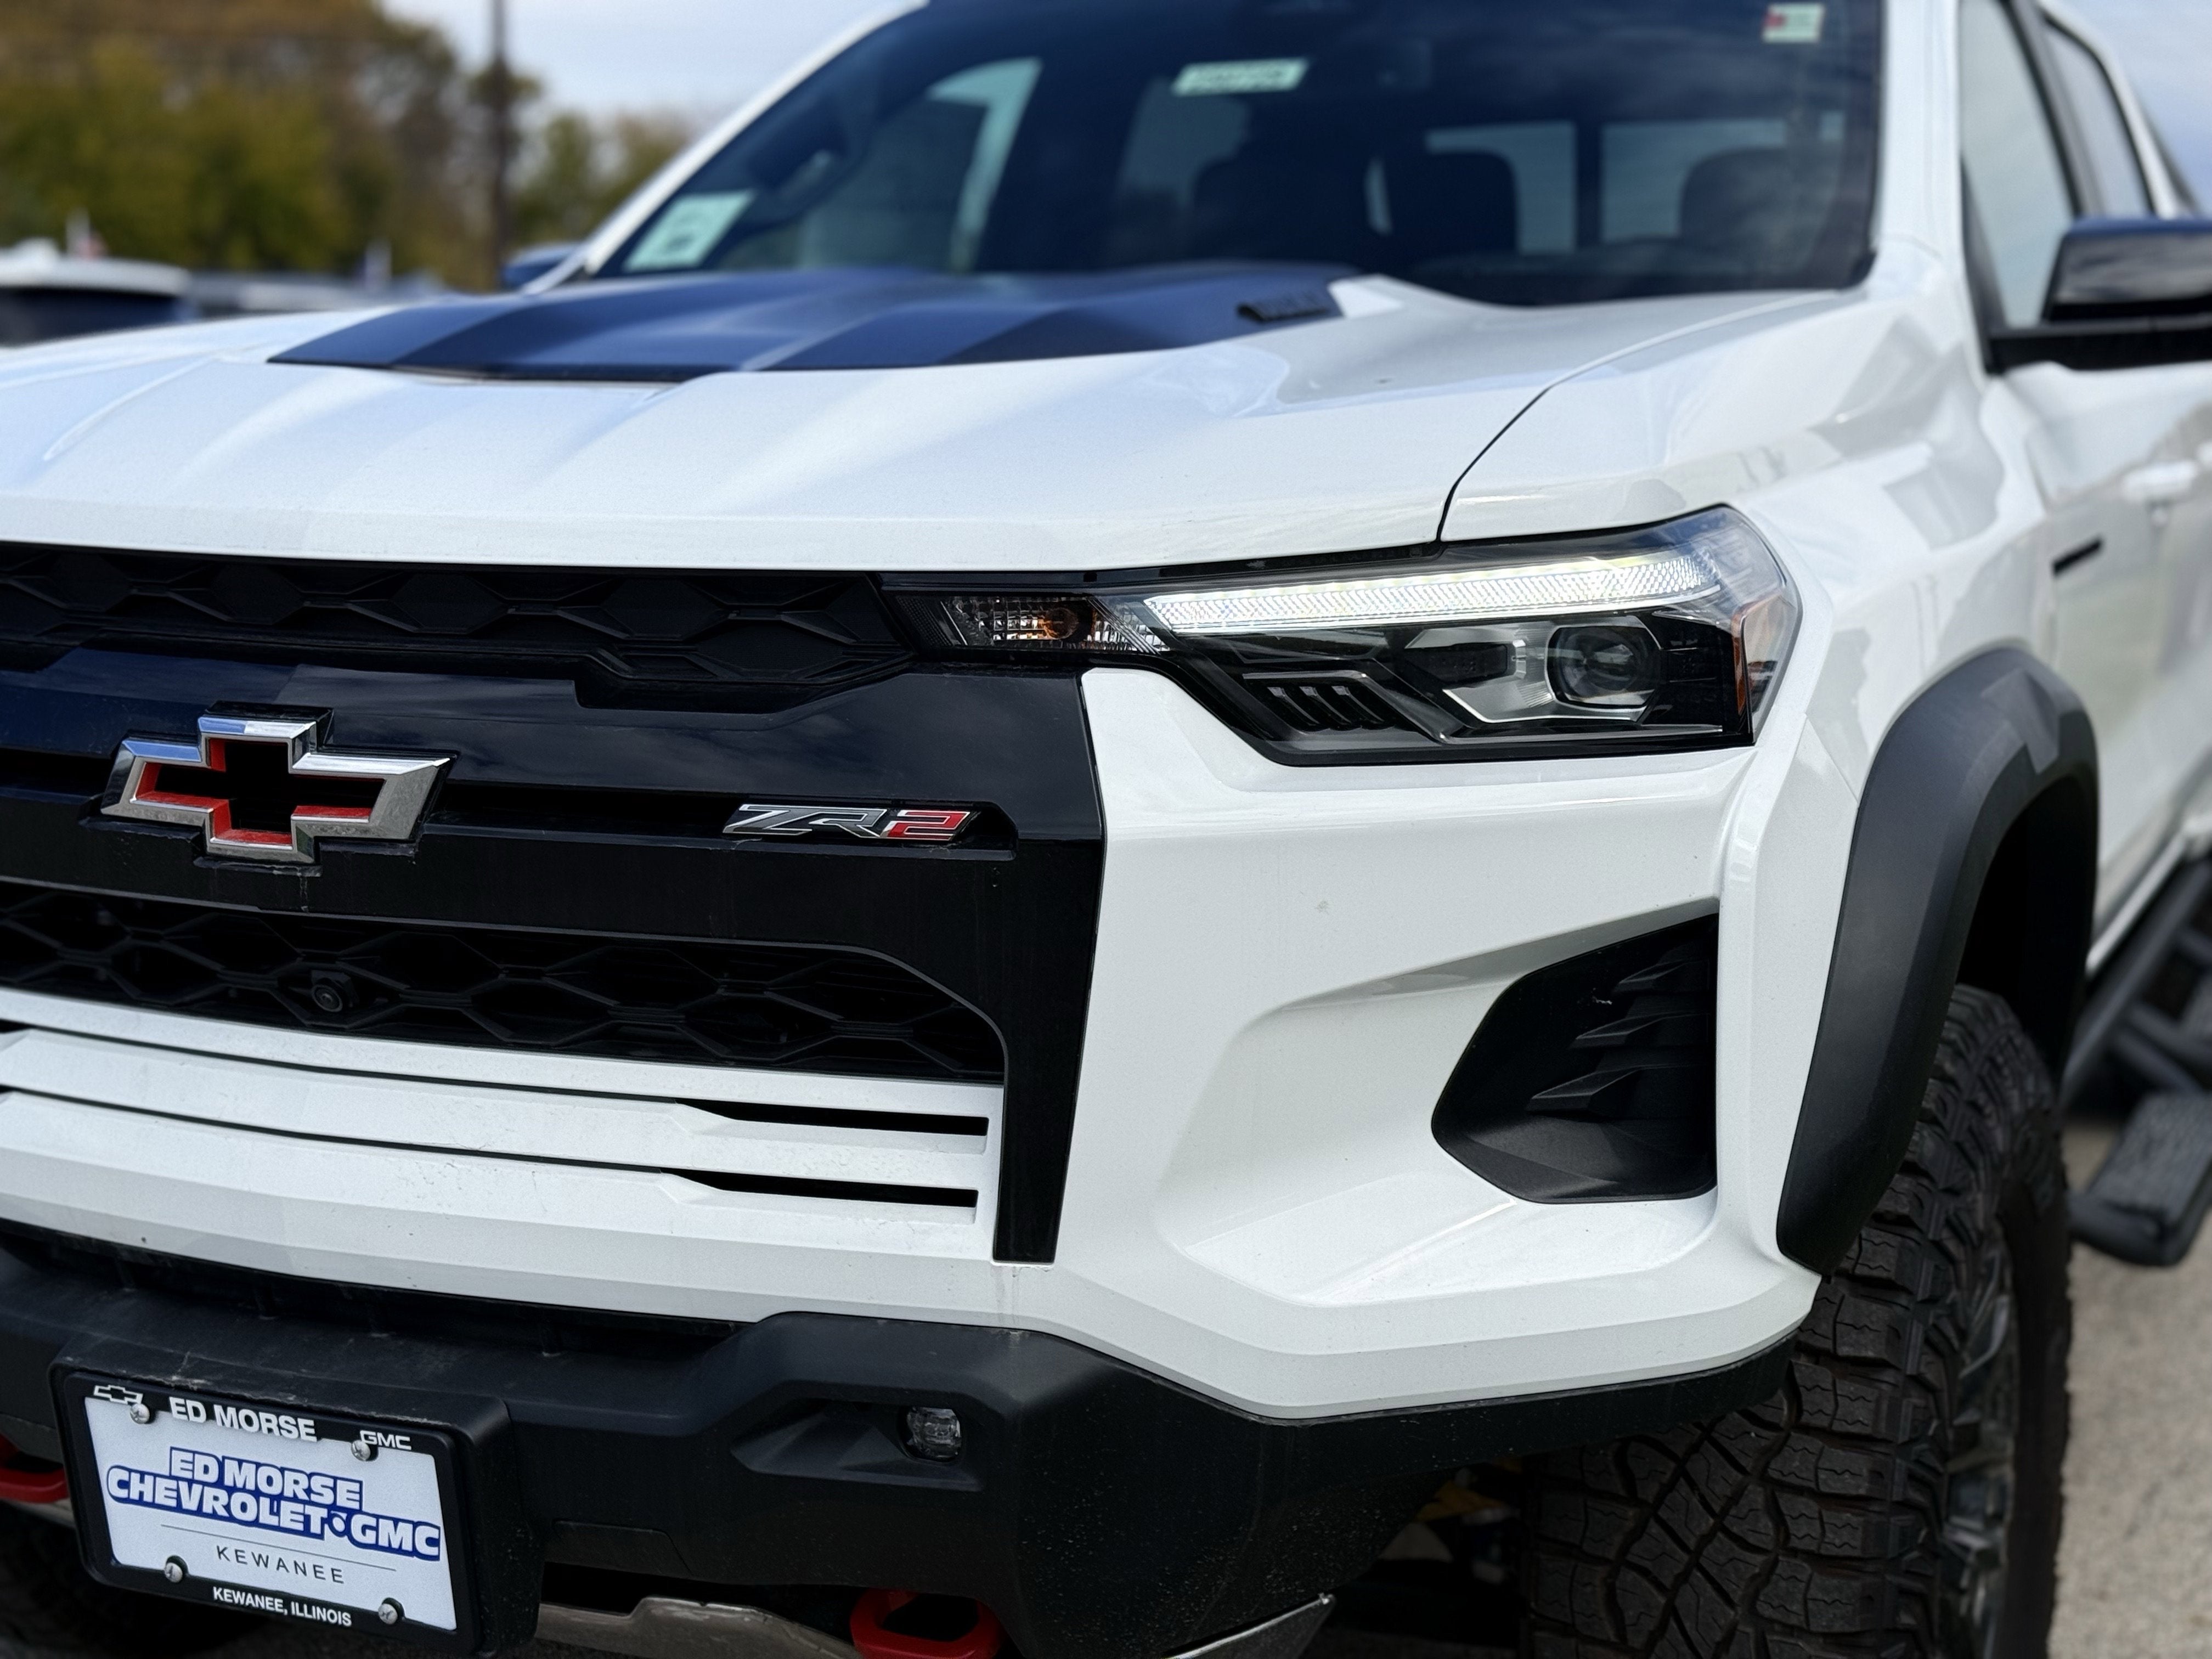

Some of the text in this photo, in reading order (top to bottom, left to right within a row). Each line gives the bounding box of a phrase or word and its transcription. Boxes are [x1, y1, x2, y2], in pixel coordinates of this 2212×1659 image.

[722, 803, 972, 841] ZR2
[169, 1396, 318, 1442] ED MORSE
[359, 1430, 412, 1451] GMC
[170, 1447, 362, 1510] ED MORSE
[216, 1544, 345, 1584] KEWANEE
[212, 1585, 352, 1627] KEWANEE, ILLINOIS
